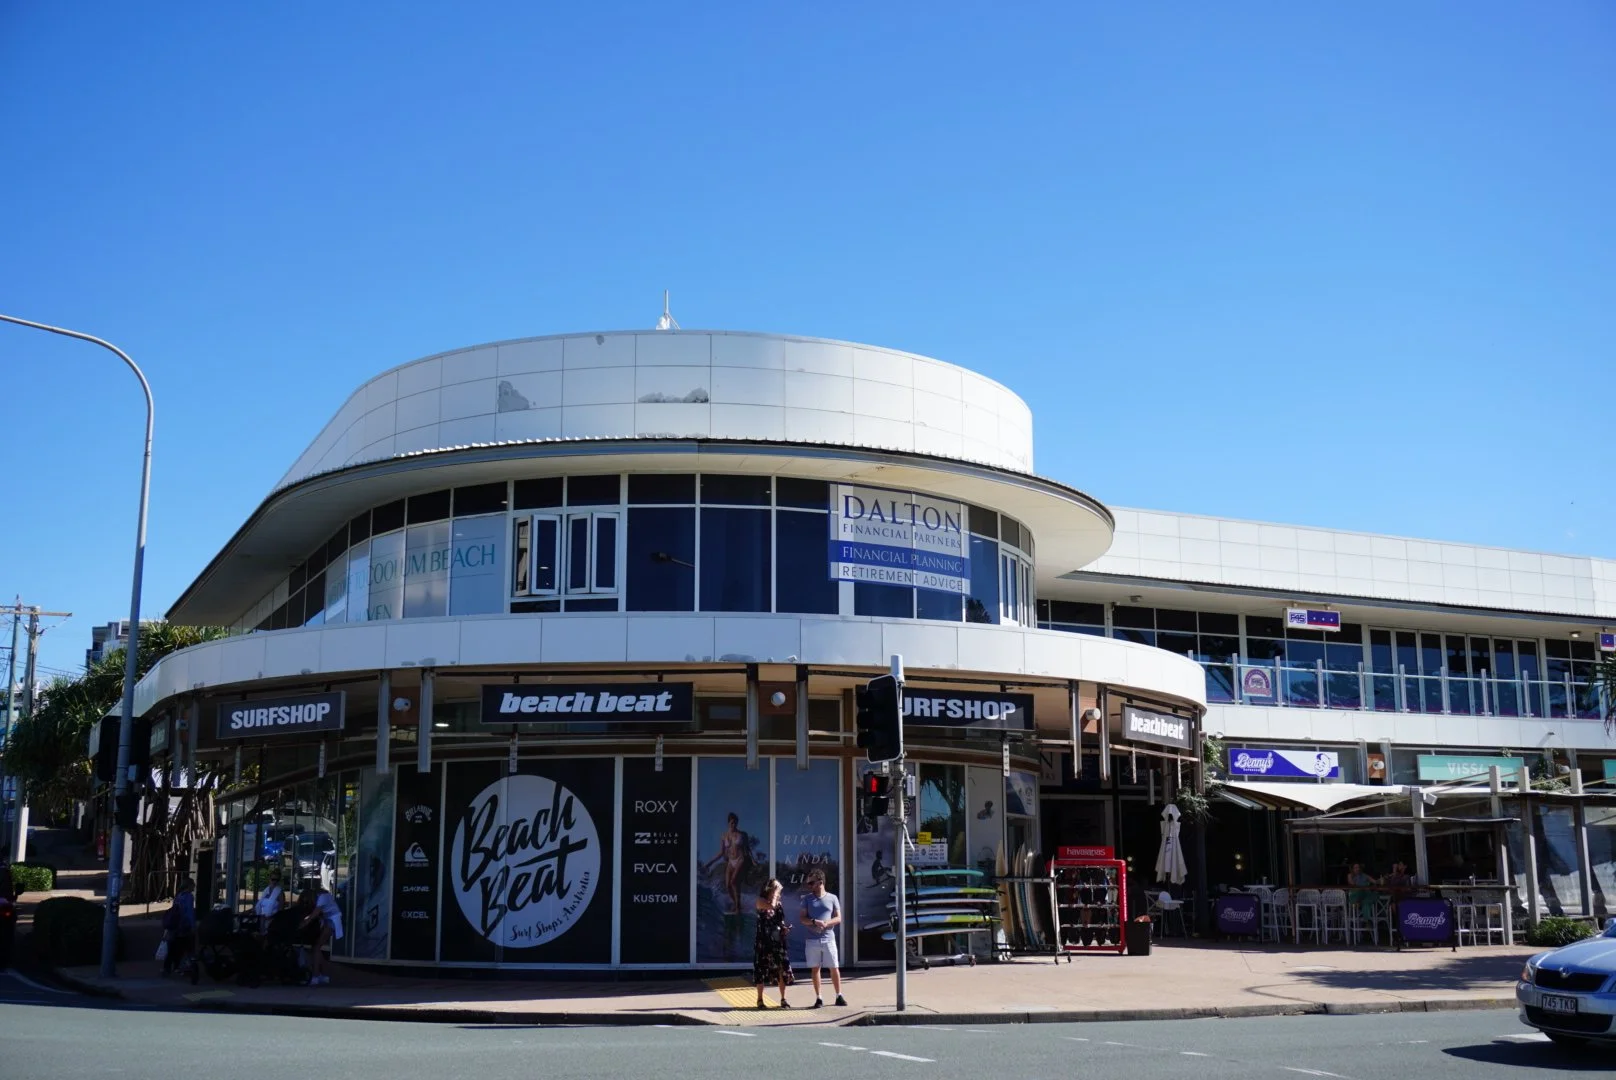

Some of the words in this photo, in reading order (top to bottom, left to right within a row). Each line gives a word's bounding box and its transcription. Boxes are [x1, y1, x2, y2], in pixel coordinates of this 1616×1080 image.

[843, 494, 961, 535] DALTON
[843, 523, 909, 540] FINANCIAL
[914, 531, 961, 549] PARTNERS
[431, 543, 495, 573] BEACH
[843, 546, 908, 564] FINANCIAL
[910, 553, 962, 573] PLANNING
[842, 566, 919, 584] RETIREMENT
[923, 574, 963, 591] ADVICE
[499, 691, 596, 714] beach
[596, 690, 673, 713] beat
[902, 696, 1016, 722] URFSHOP
[230, 702, 331, 730] SURFSHOP
[1234, 752, 1274, 774] Benny's
[1448, 762, 1489, 775] VISSL
[635, 800, 679, 813] ROXY
[803, 815, 811, 825] A
[461, 781, 576, 892] Beach
[783, 835, 832, 845] BIKINI
[633, 863, 678, 873] RVCA
[784, 854, 829, 864] KINDA
[480, 835, 588, 939] Beat
[789, 873, 806, 884] LI
[510, 924, 532, 943] Surf
[535, 917, 563, 939] Shops
[563, 871, 591, 920] Australia
[633, 894, 678, 903] KUSTOM
[1403, 911, 1446, 930] Benny's
